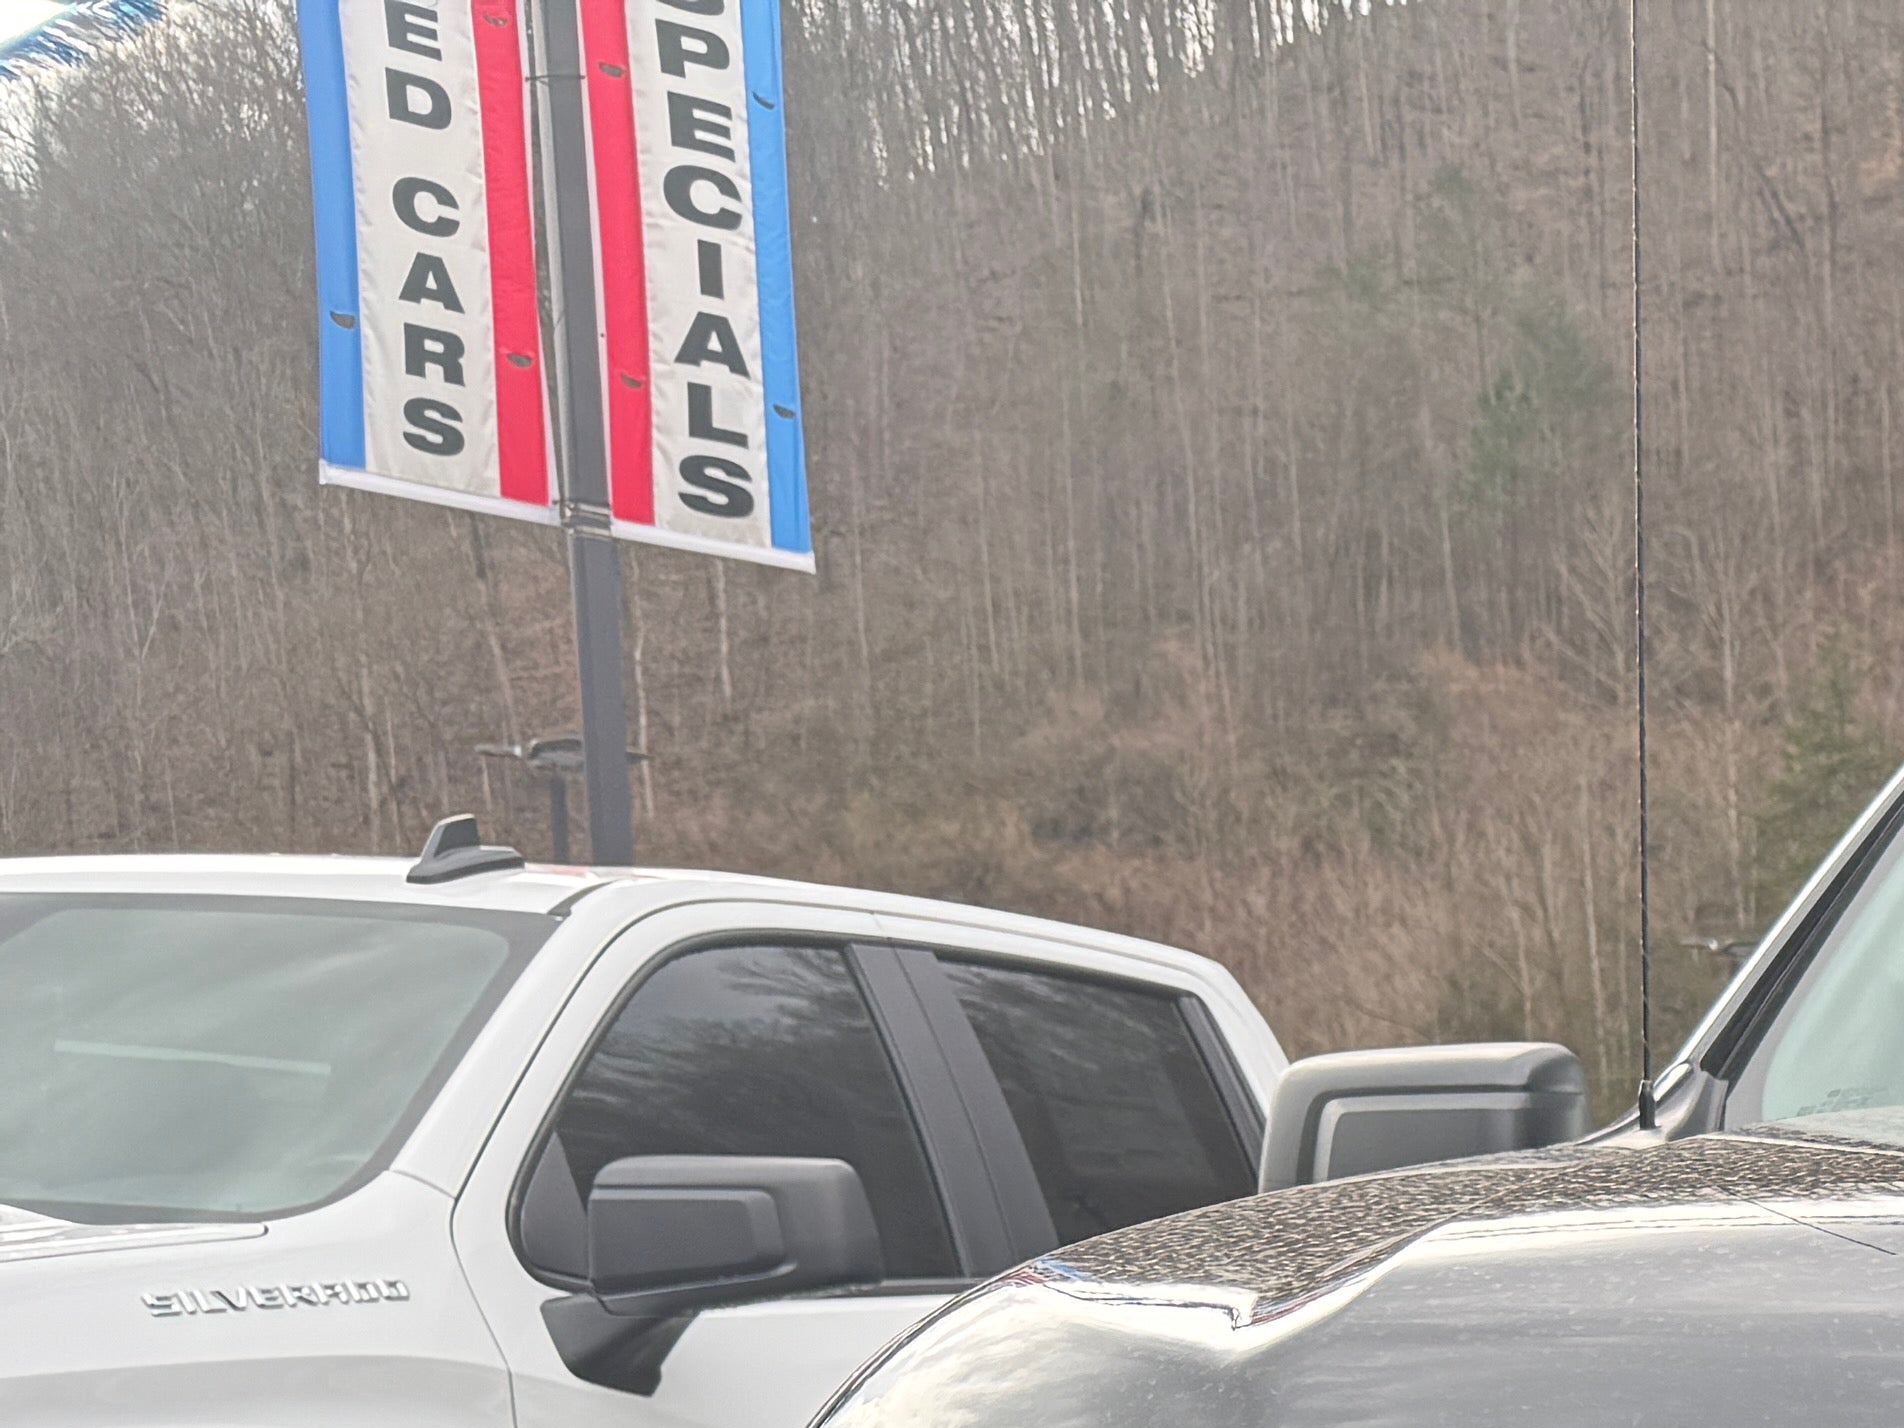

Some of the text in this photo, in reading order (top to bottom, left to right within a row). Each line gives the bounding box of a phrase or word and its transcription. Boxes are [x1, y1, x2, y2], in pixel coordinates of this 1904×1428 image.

[384, 0, 465, 457] ED CARS
[655, 0, 755, 519] PECIALS
[141, 1278, 410, 1317] SILVERADO
